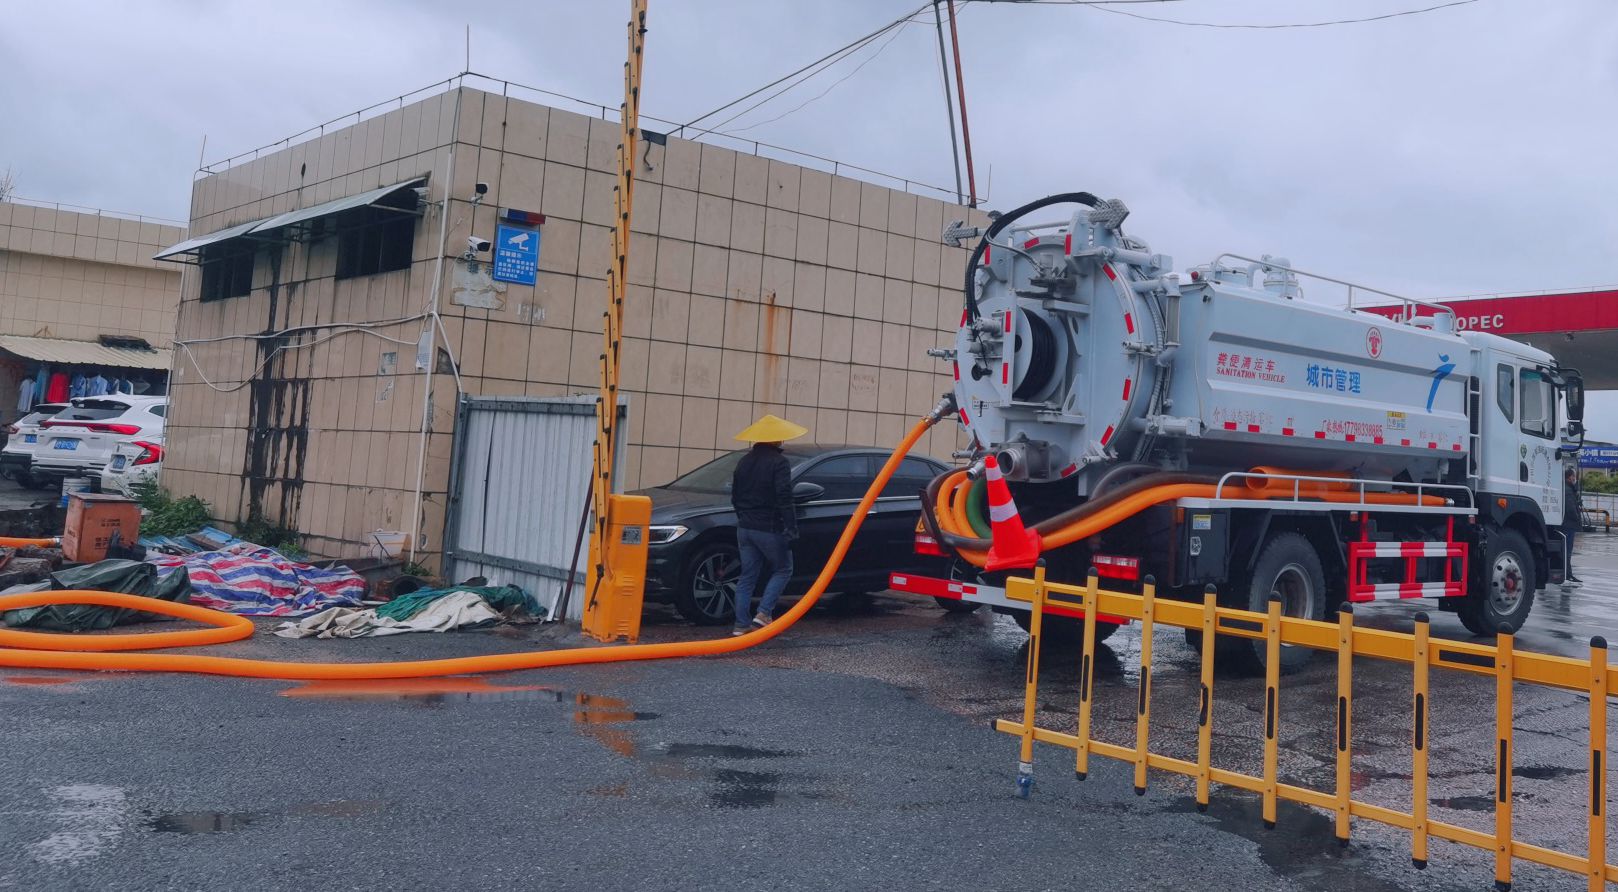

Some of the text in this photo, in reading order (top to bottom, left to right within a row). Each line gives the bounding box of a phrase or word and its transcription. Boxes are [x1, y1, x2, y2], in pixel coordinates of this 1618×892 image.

[1455, 314, 1504, 330] OPEC
[1217, 352, 1276, 372] 粪便清运车
[1216, 367, 1286, 383] SANITATION VEHICLE
[1306, 363, 1361, 393] 城市管理
